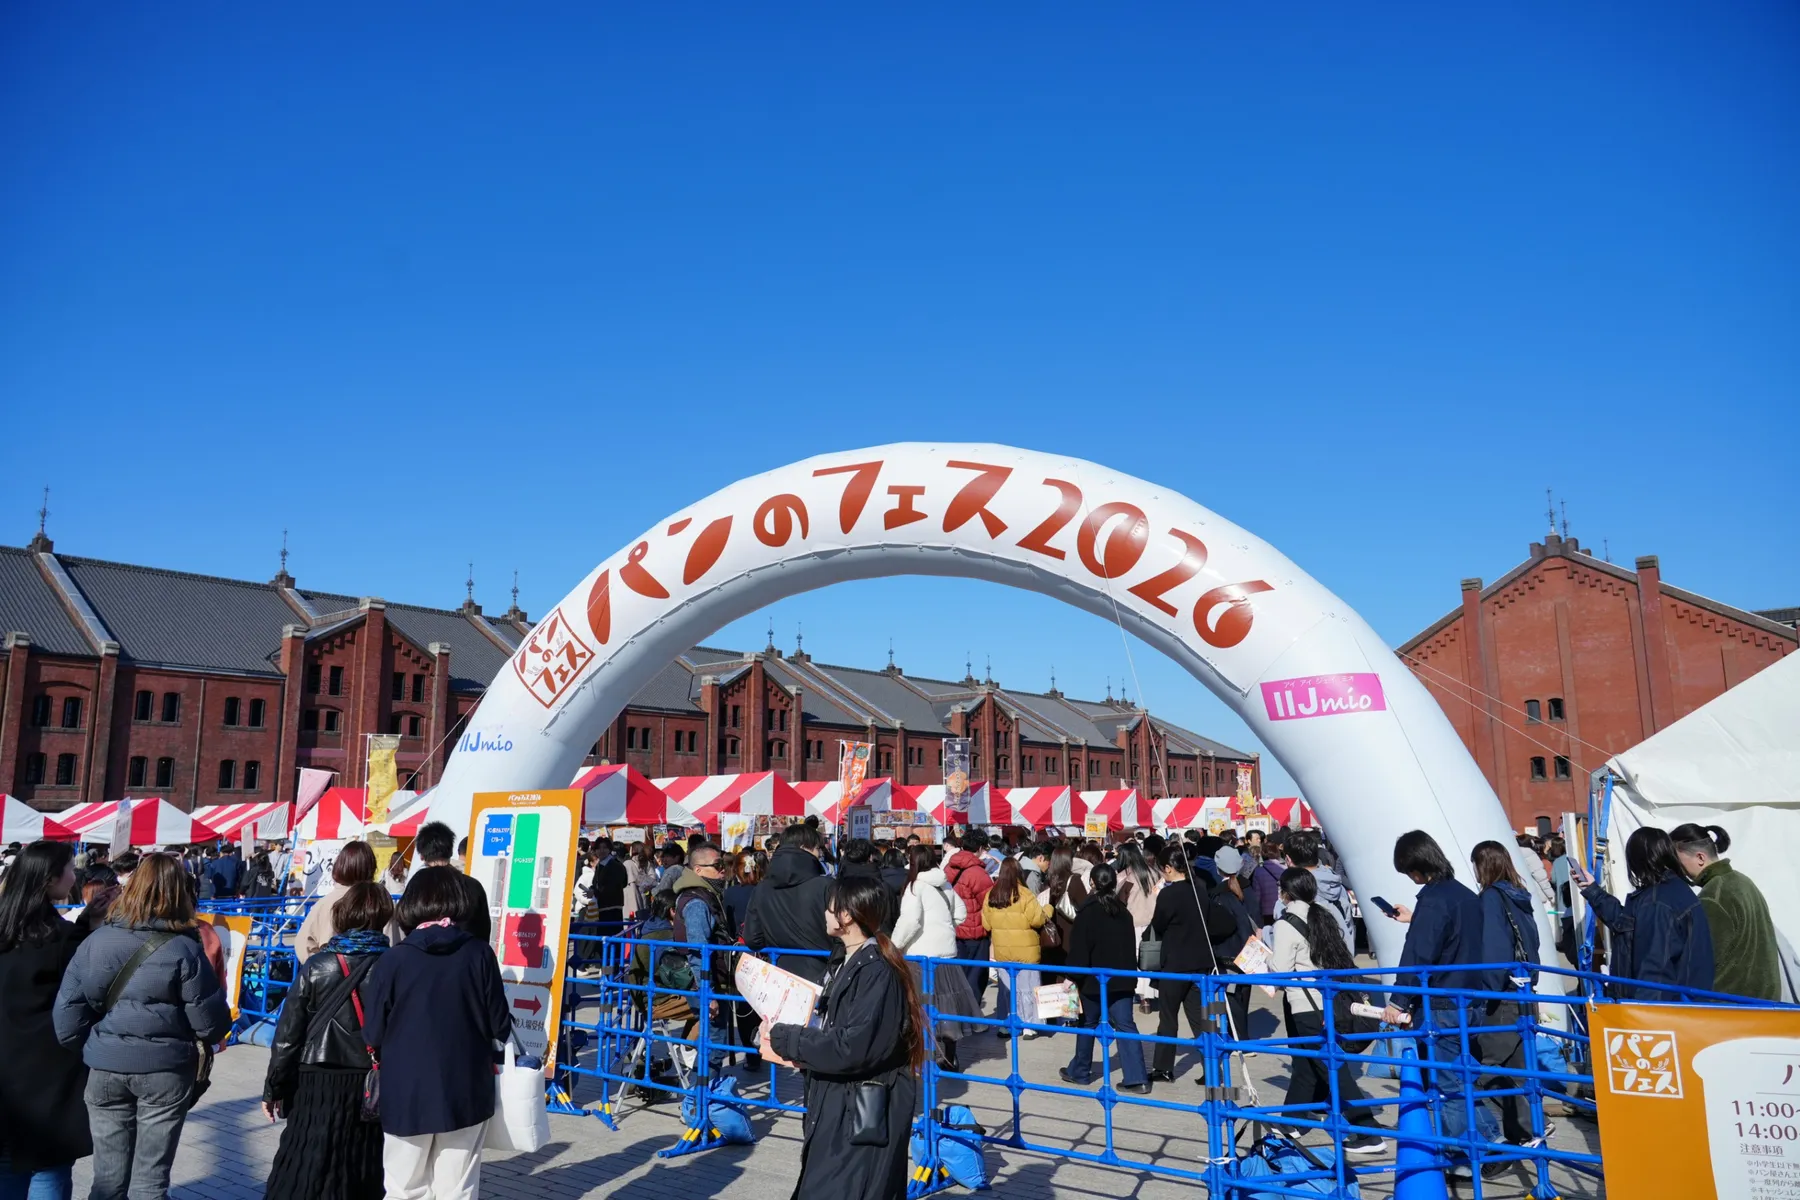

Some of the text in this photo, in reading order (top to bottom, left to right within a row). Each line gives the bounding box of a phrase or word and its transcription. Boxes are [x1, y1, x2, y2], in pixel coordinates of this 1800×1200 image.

[587, 460, 1275, 648] パンのフェス2026
[1273, 687, 1371, 717] IIJmio
[459, 732, 513, 752] IIJmio
[1610, 1034, 1672, 1058] パン
[1636, 1057, 1650, 1070] の
[1612, 1067, 1677, 1094] フェス
[1735, 1122, 1800, 1141] 14:00
[1740, 1143, 1784, 1155] 注意事項
[1748, 1169, 1800, 1178] ※パン屋さんエ
